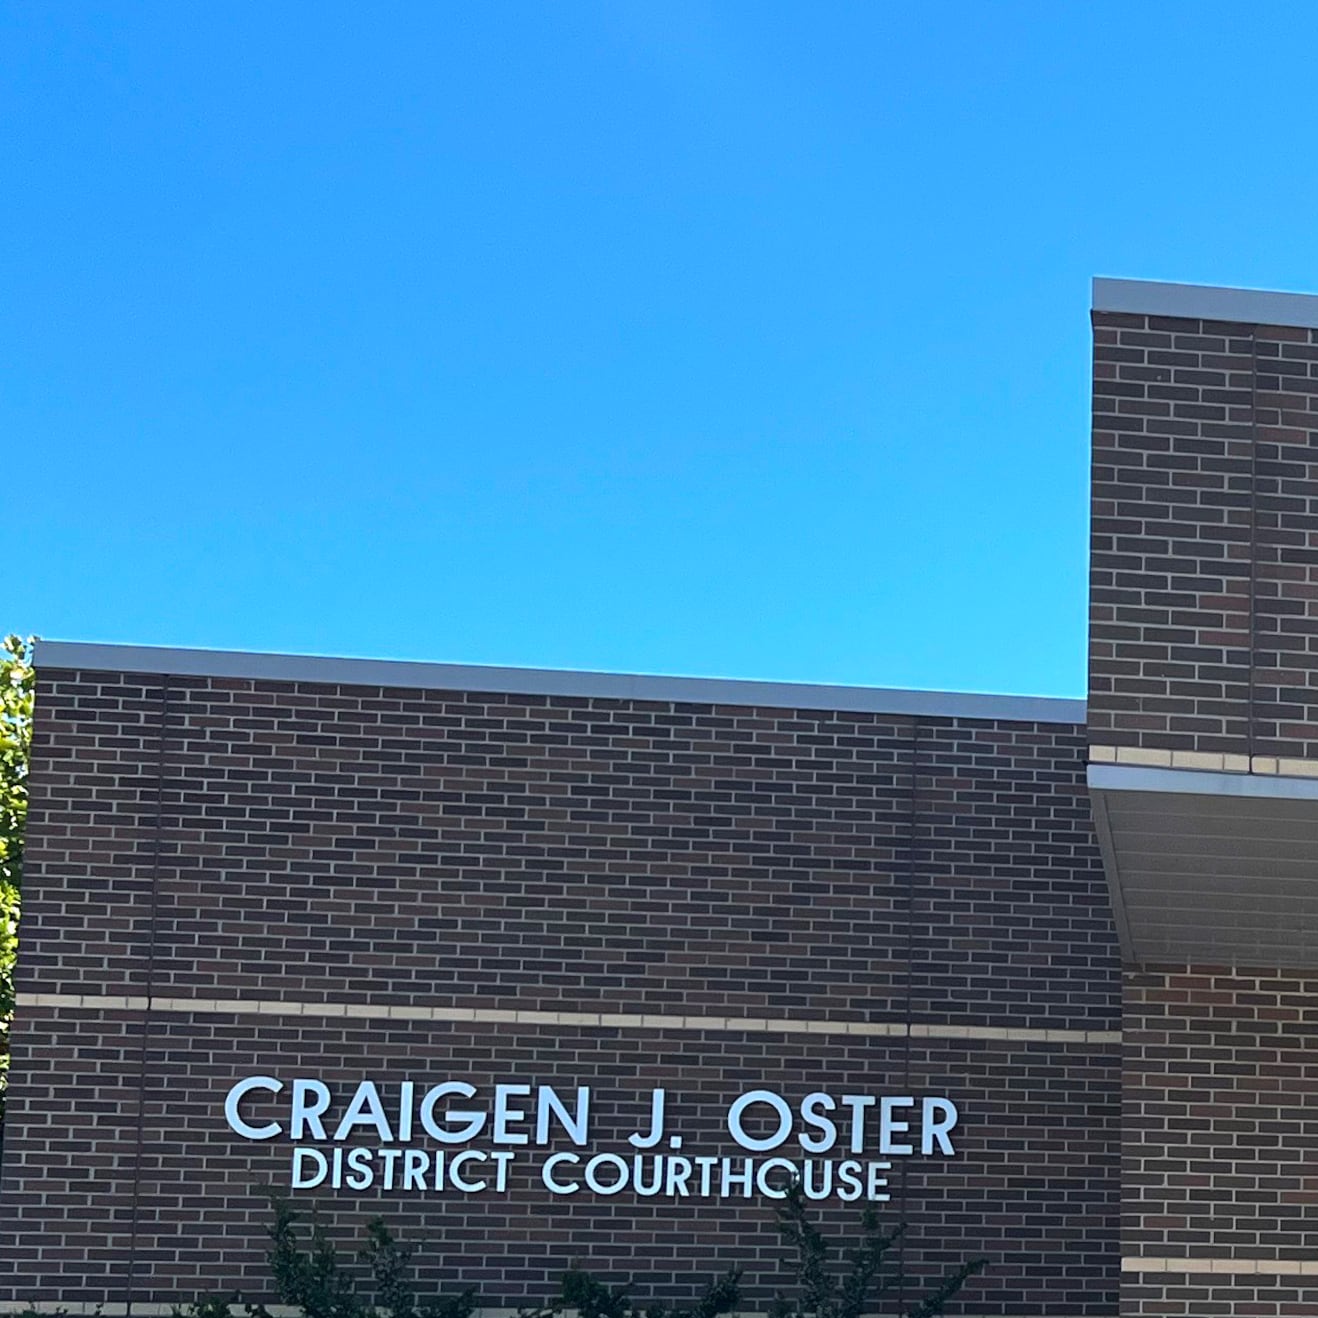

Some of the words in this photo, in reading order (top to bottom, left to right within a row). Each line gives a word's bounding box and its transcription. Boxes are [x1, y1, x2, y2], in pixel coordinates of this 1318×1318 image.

[223, 1075, 590, 1146] CRAIGEN
[628, 1087, 684, 1150] J.
[727, 1089, 960, 1157] OSTER
[291, 1146, 516, 1194] DISTRICT
[542, 1151, 894, 1203] COURTHOUSE
